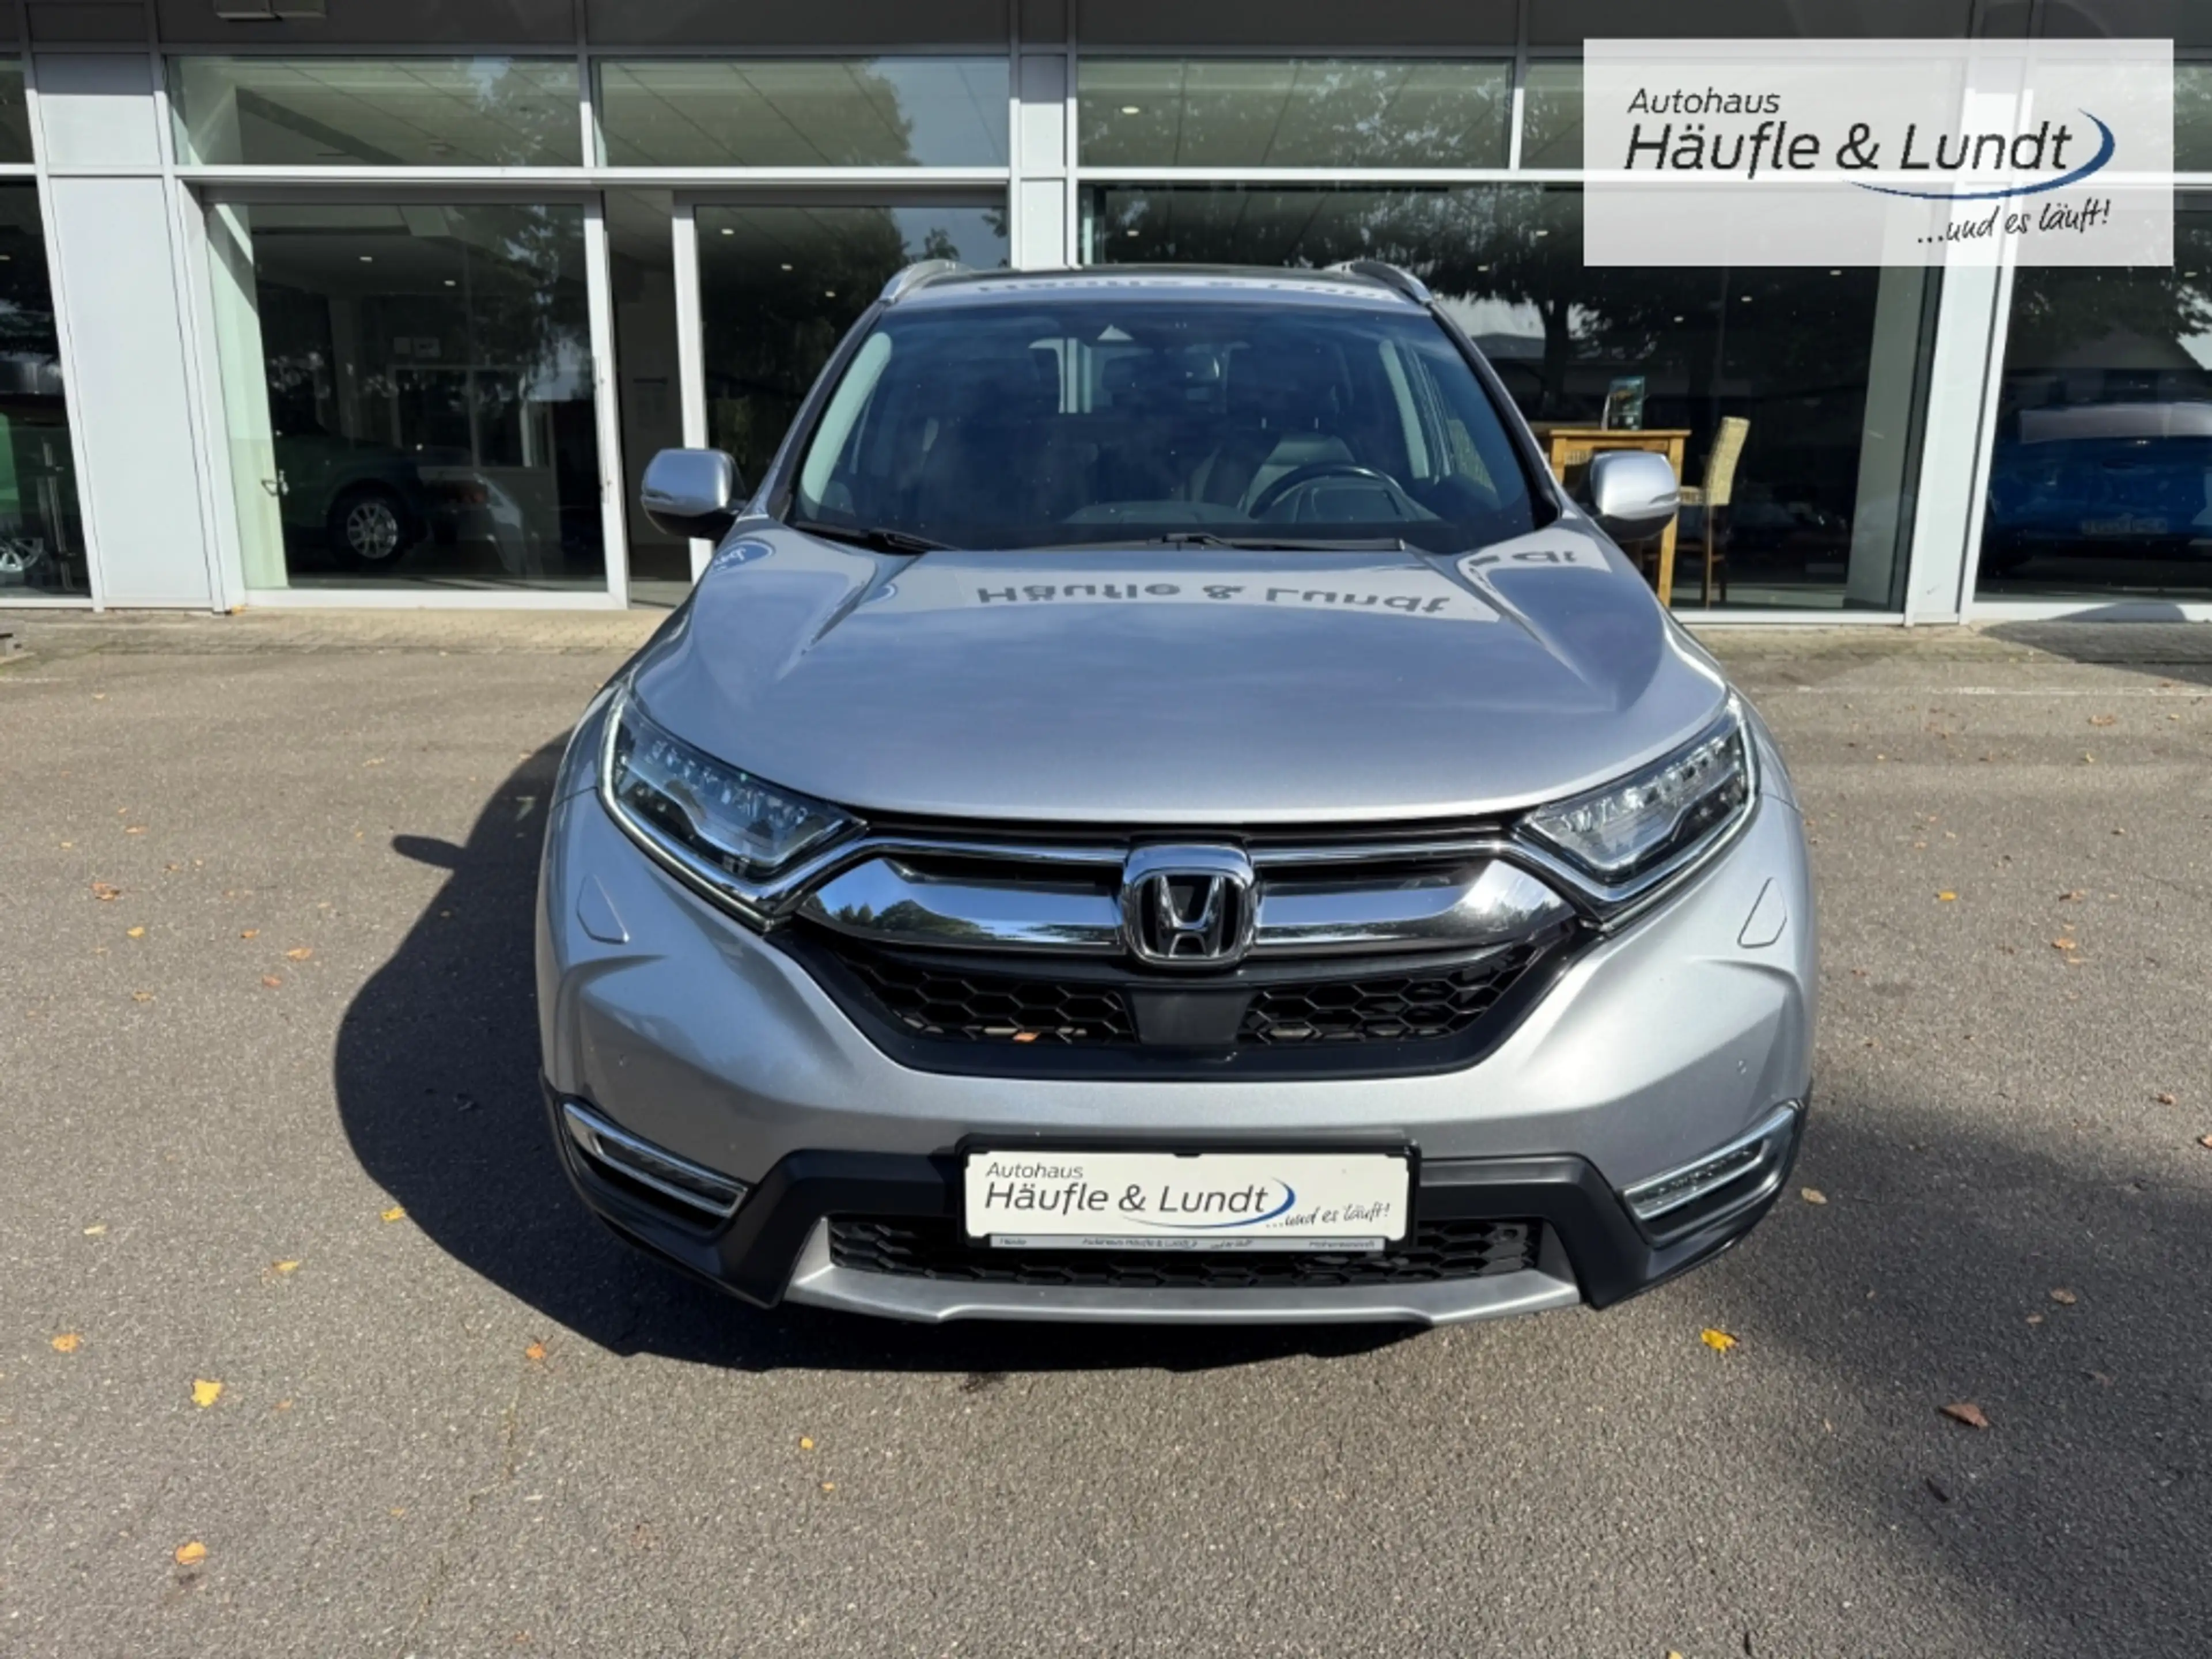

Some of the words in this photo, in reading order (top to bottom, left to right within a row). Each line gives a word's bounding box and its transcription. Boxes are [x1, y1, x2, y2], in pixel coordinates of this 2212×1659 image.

[986, 1161, 1084, 1179] Autohaus
[984, 1181, 1109, 1215] Häufle
[1118, 1184, 1146, 1211] &
[1159, 1185, 1268, 1213] Lundt
[1321, 1210, 1339, 1223] es
